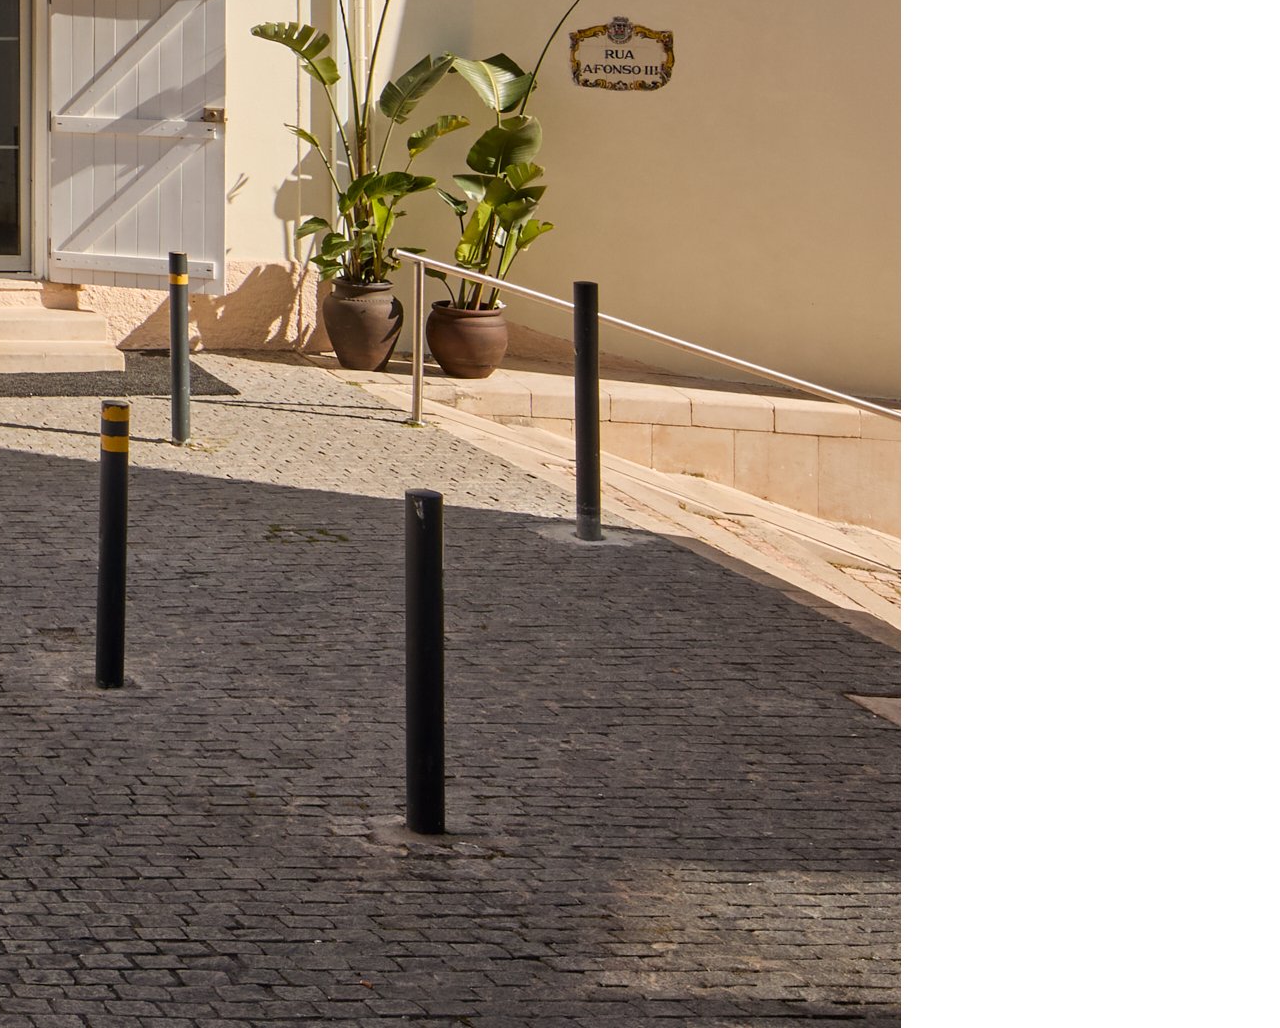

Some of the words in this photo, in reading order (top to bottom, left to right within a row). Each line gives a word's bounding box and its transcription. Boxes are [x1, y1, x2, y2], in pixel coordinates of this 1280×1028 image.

[604, 49, 634, 60] RUA
[582, 64, 642, 75] AFONSO
[644, 65, 658, 76] III
